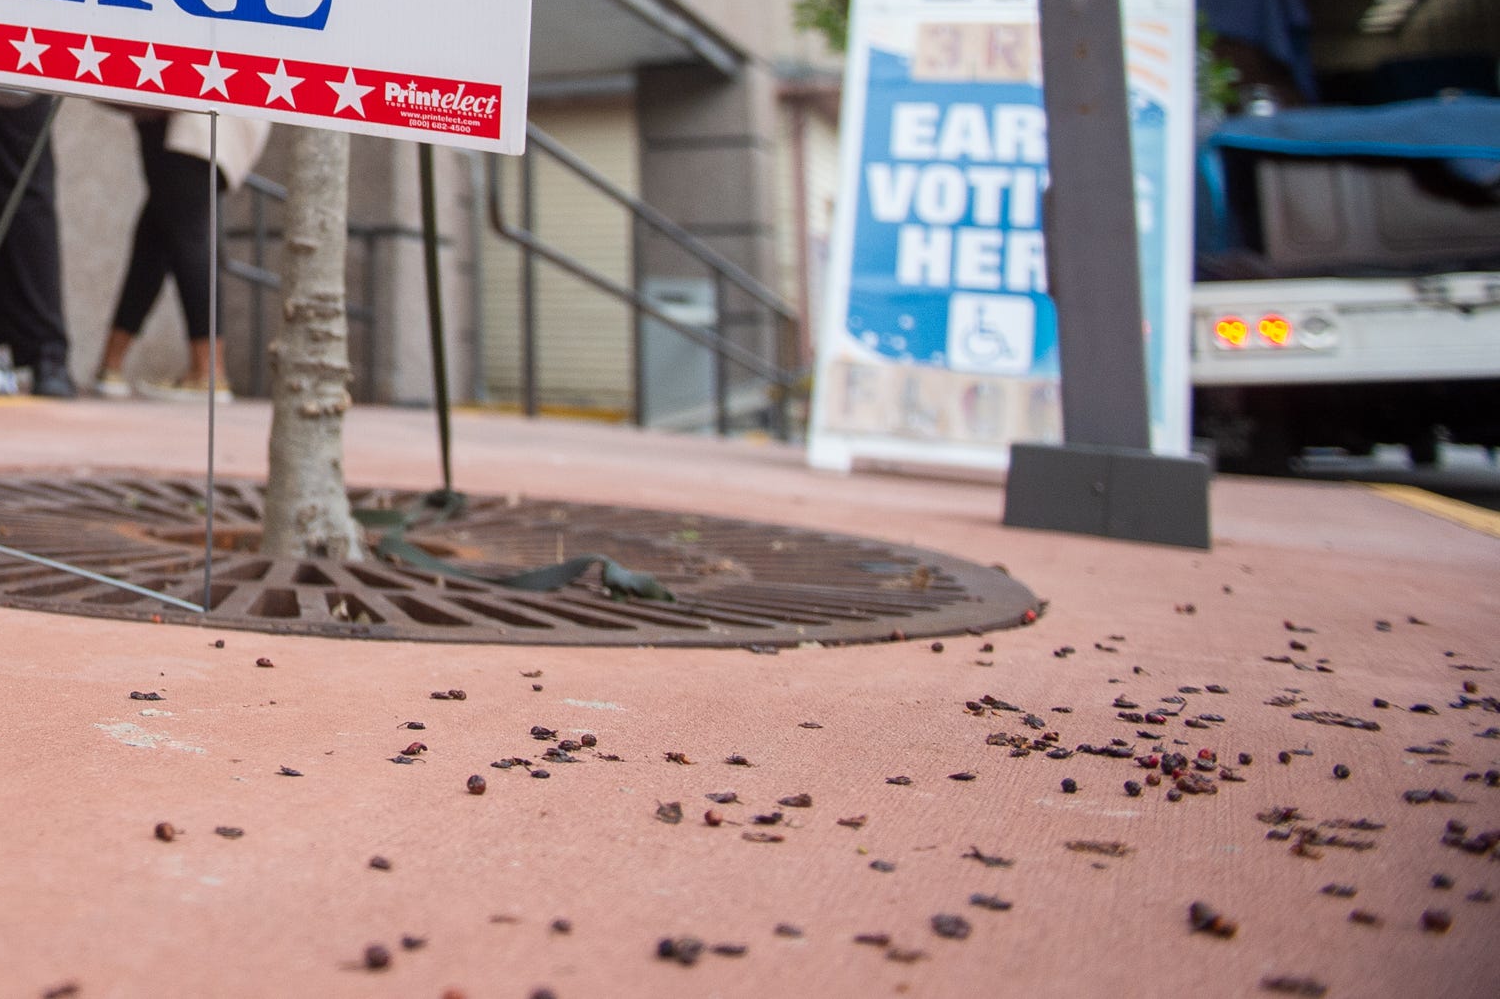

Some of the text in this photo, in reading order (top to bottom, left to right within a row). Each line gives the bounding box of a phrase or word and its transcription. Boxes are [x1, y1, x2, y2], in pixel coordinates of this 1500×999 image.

[923, 24, 1026, 71] 3R
[384, 79, 499, 115] Printelect
[400, 110, 481, 127] www.printelect.com
[409, 118, 472, 134] (800) 682-4500
[891, 100, 1047, 163] EAR
[865, 162, 1051, 228] VOTI
[898, 223, 1049, 294] HER
